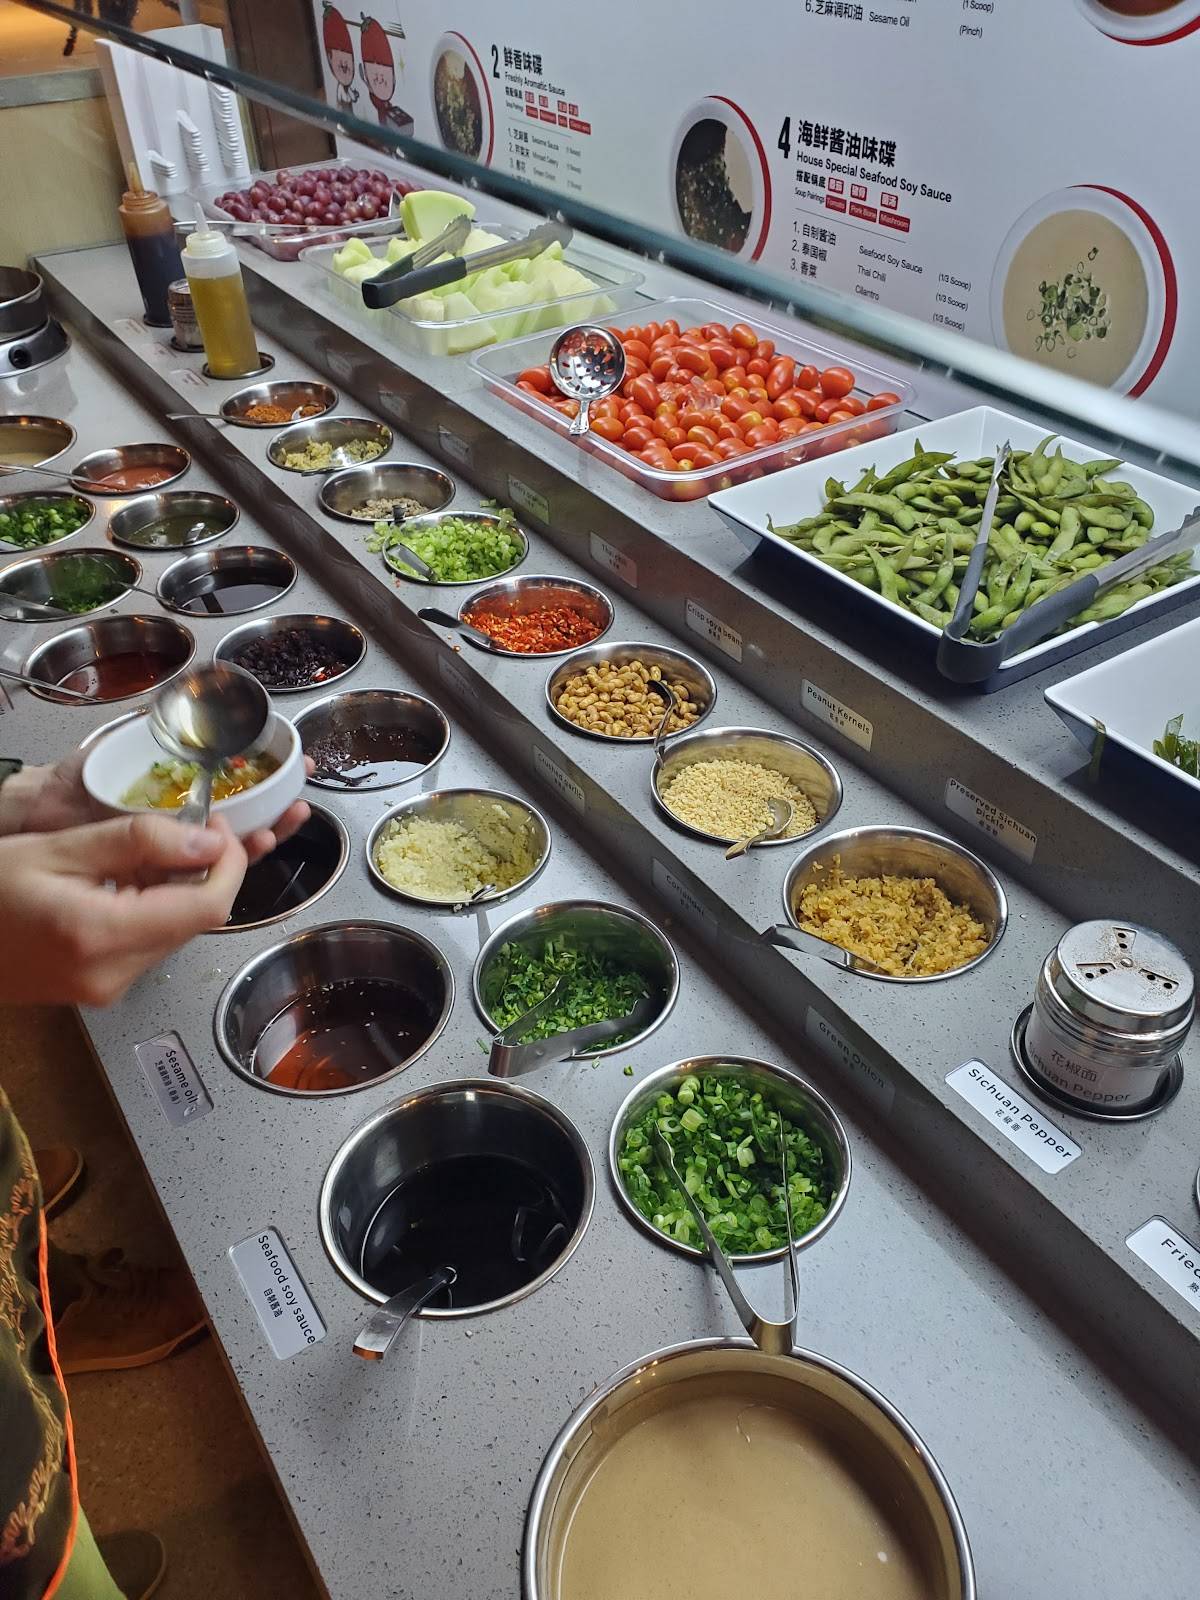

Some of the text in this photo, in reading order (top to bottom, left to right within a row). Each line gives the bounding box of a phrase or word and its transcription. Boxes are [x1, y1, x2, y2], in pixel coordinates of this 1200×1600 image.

[869, 11, 898, 26] Sesame
[900, 16, 910, 27] Oil
[960, 25, 983, 38] (Pinch)
[970, 0, 994, 14] Scoop)
[491, 44, 500, 79] 2
[778, 116, 791, 159] 4
[798, 119, 896, 168] 海鲜酱油味碟
[796, 150, 952, 203] House Special Seafood Soy Sauce
[858, 265, 872, 277] Thai
[859, 245, 886, 262] Seafood
[887, 254, 900, 268] Soy
[901, 259, 923, 274] Sauce
[855, 284, 880, 301] Cilantro
[950, 276, 971, 291] Scoop)
[947, 296, 969, 311] Scoop)
[807, 686, 836, 712] Peanut
[837, 707, 870, 735] Kernels
[950, 779, 997, 816] Preserved
[999, 810, 1037, 843] Sichuan
[819, 1021, 850, 1056] Green
[851, 1053, 885, 1089] Onion
[1051, 1049, 1098, 1082] 花椒面
[166, 1050, 199, 1104] Sesame oil
[1073, 1084, 1131, 1102] Pepper
[968, 1068, 1072, 1158] Sichuan Pepper
[258, 1235, 316, 1344] Seafood soy sauce
